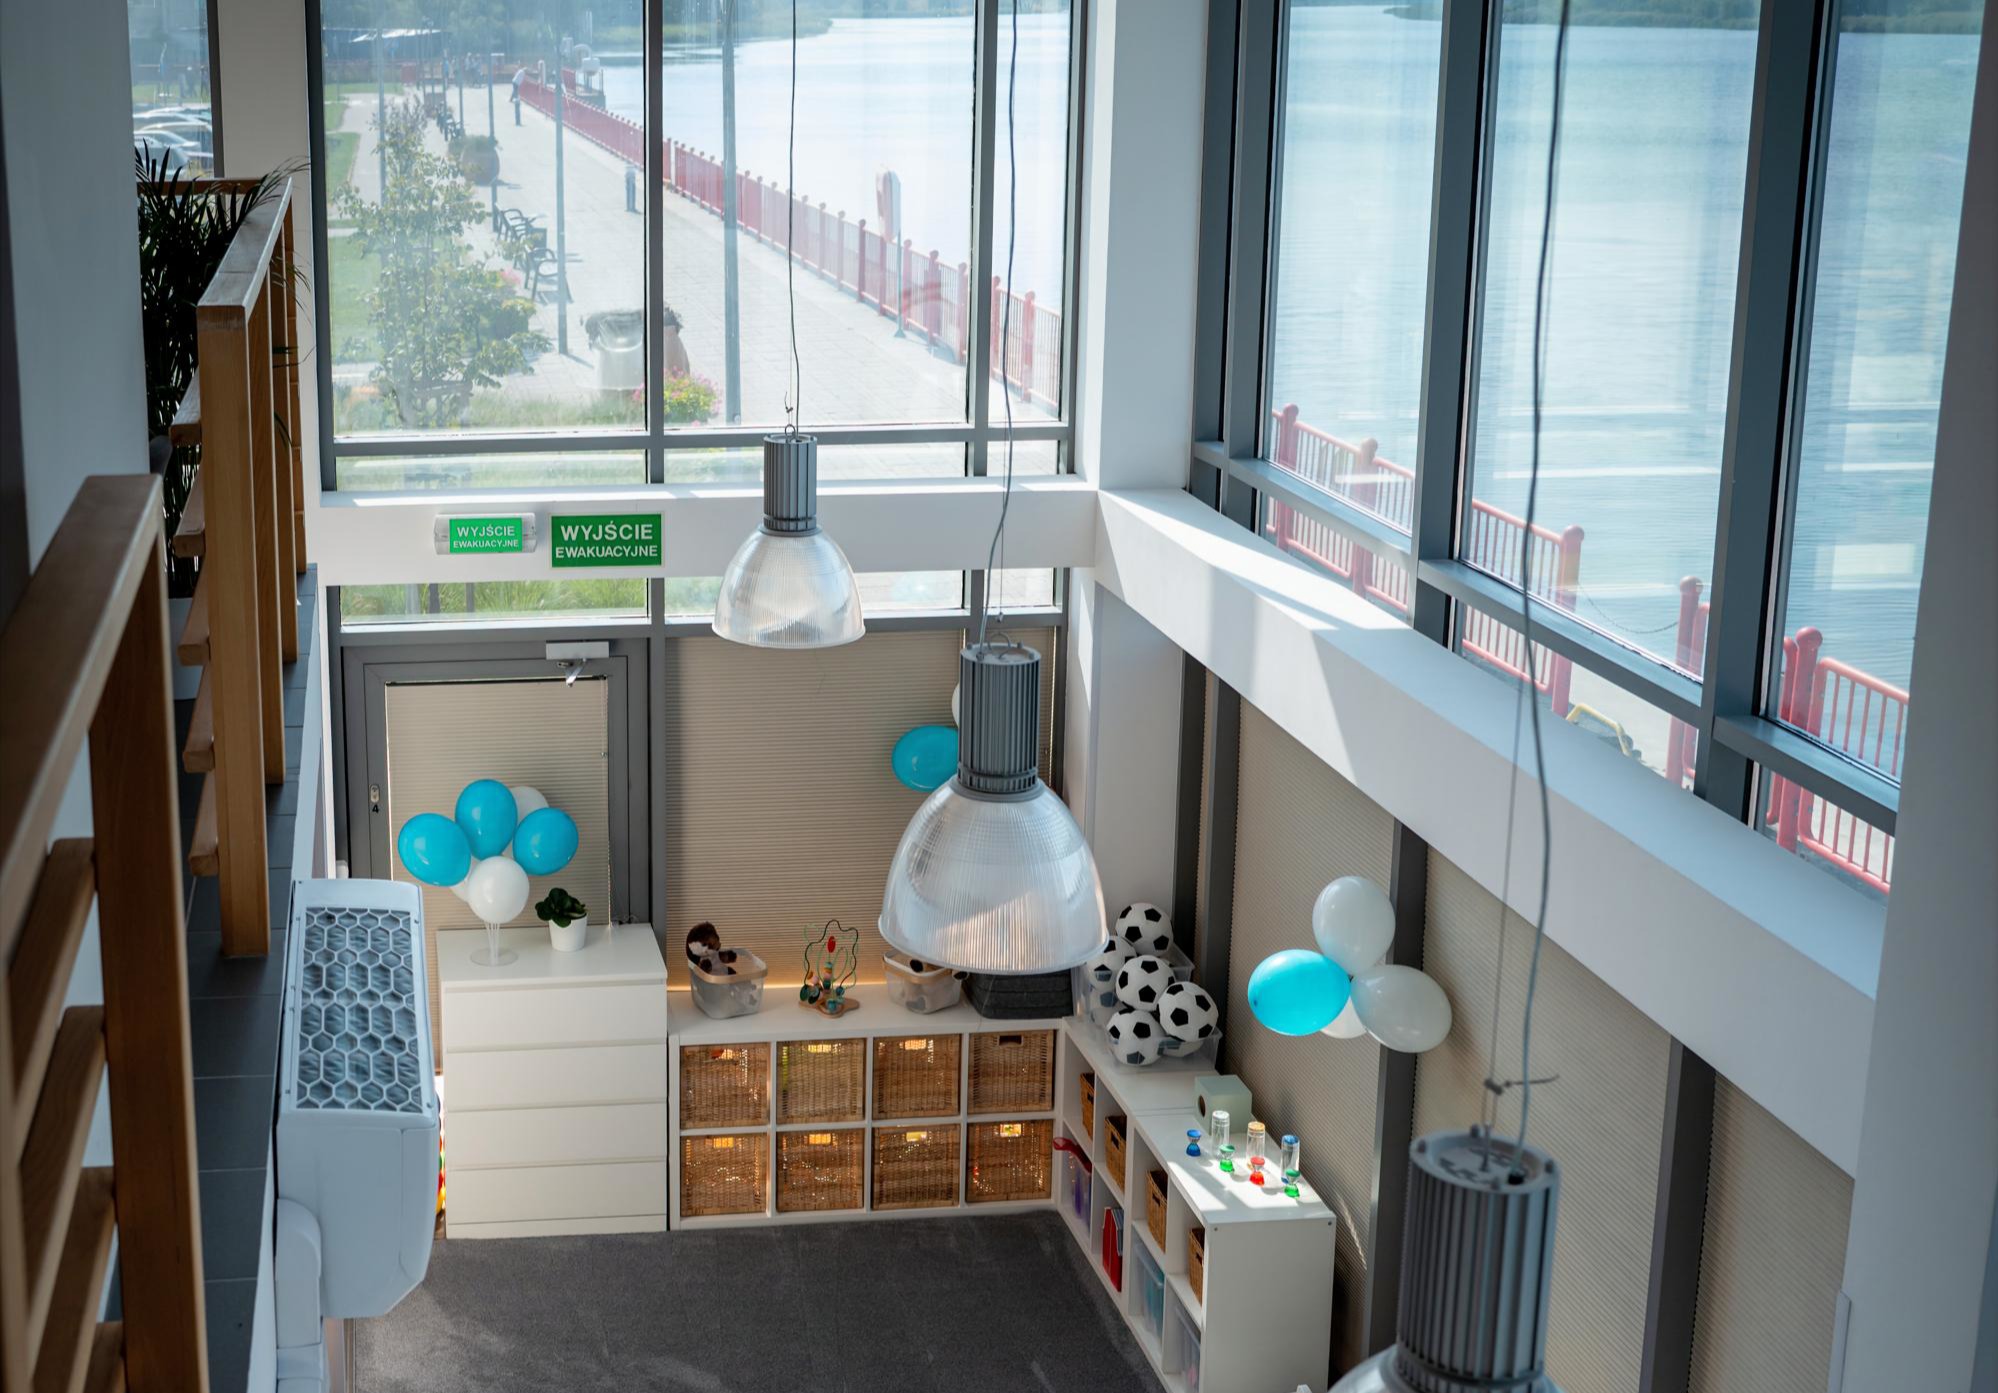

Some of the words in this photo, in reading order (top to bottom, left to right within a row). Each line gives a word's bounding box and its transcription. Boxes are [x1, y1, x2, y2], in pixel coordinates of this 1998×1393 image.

[457, 524, 514, 537] WYJŚCIE
[561, 520, 652, 541] WYJŚCIE
[453, 539, 519, 549] EWAKUACYJNE
[555, 545, 658, 558] EWAKUACYJNE
